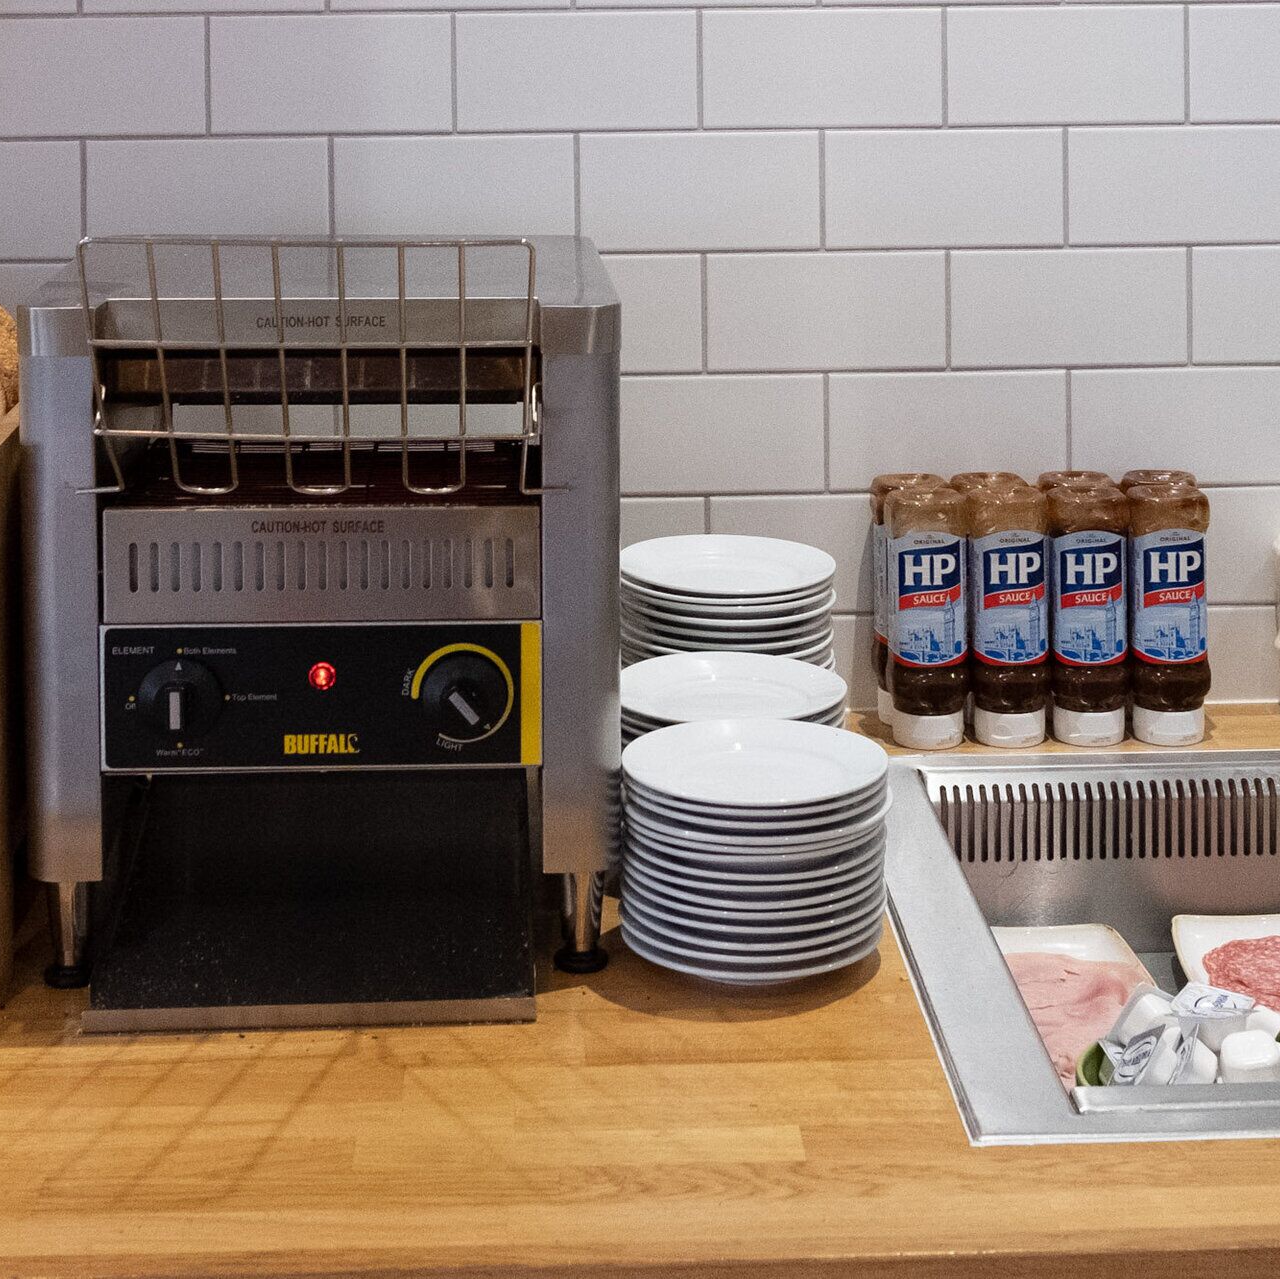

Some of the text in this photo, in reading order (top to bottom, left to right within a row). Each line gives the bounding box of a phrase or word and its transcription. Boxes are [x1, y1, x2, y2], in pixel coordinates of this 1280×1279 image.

[333, 521, 384, 533] SURFACE
[903, 553, 956, 586] HP
[989, 551, 1041, 585] HP
[1065, 552, 1118, 585] HP
[1149, 550, 1202, 583] HP
[913, 594, 946, 605] SAUCE
[999, 592, 1031, 603] SAUCE
[1075, 592, 1107, 604] SAUCE
[1159, 590, 1191, 602] SAUCE
[112, 646, 155, 655] ELEMENT
[402, 668, 415, 696] DARK
[232, 692, 278, 702] Top Element
[436, 738, 464, 752] LIGHT
